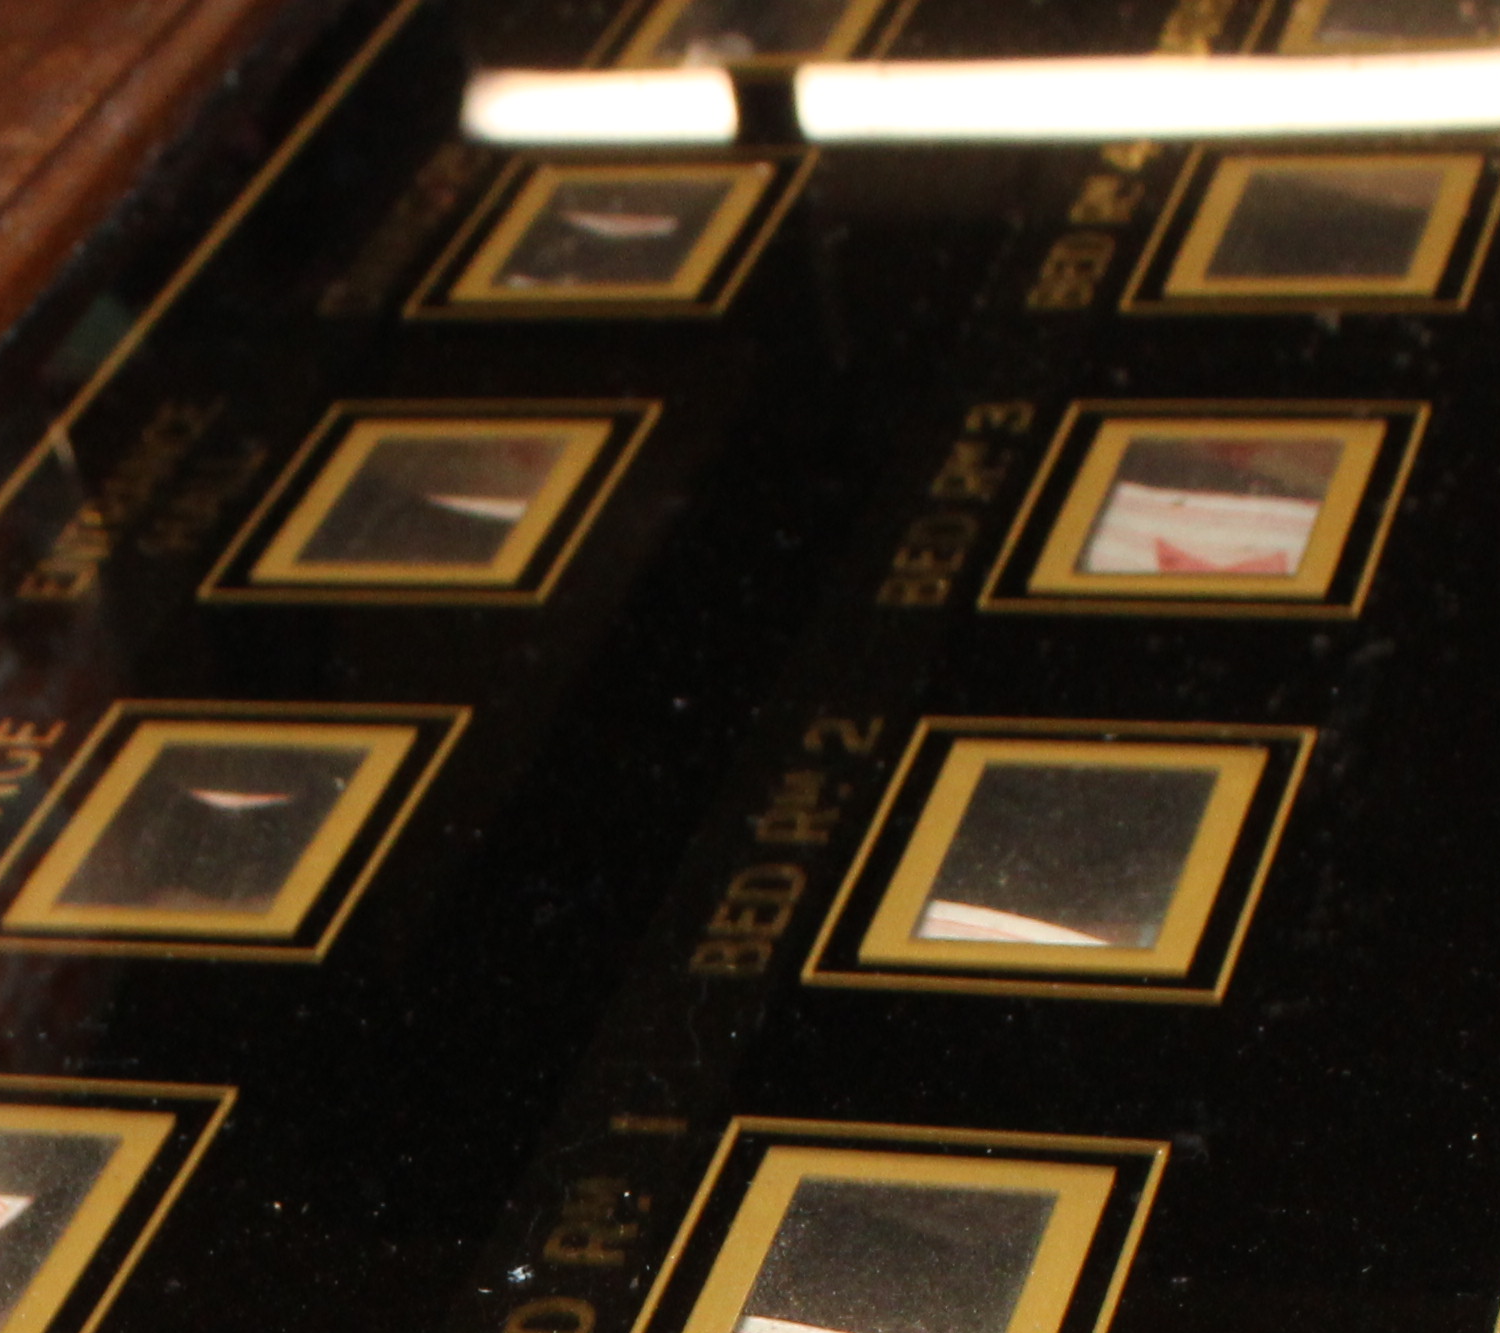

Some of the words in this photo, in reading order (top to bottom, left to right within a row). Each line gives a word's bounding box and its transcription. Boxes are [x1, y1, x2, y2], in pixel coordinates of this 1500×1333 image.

[876, 510, 979, 607] BED
[964, 402, 1036, 434] 3
[689, 862, 808, 977] BED
[802, 716, 886, 753] 2
[609, 1113, 689, 1135] 1
